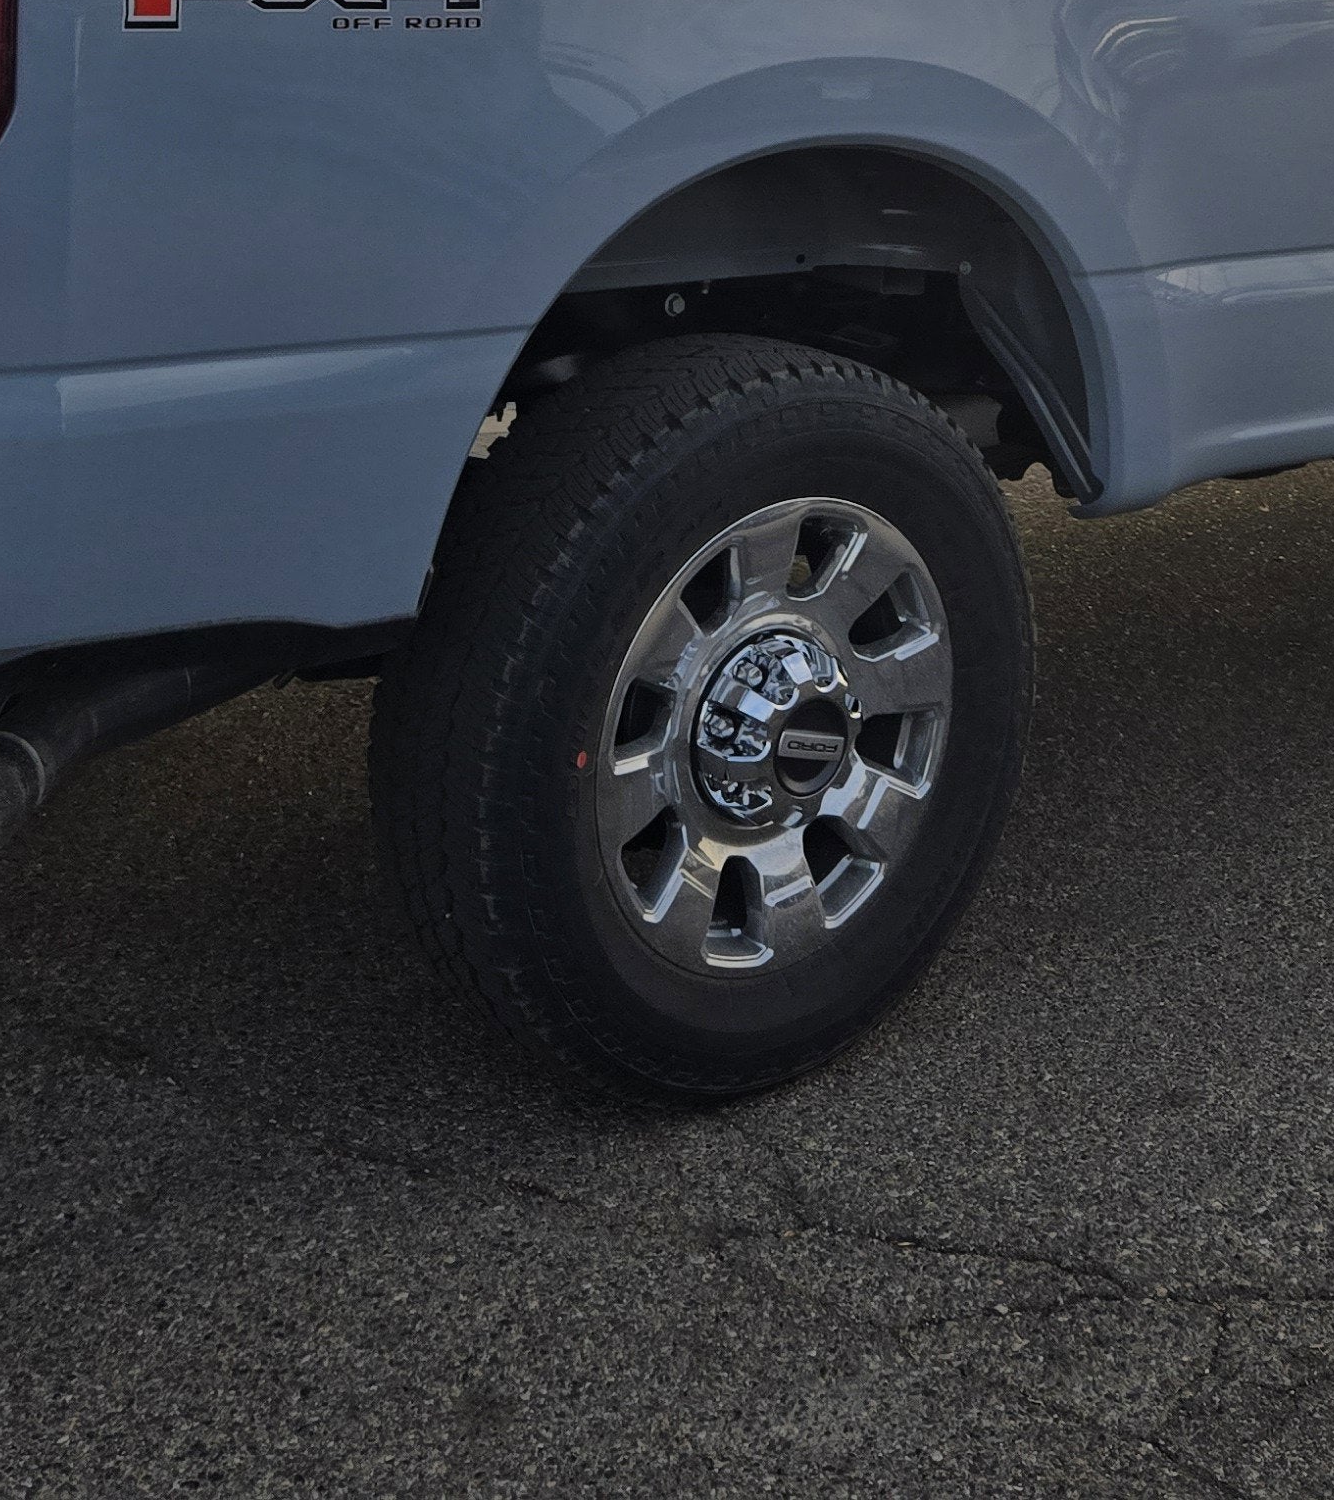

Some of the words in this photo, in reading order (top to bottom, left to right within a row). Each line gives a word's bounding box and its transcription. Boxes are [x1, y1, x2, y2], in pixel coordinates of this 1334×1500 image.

[331, 16, 392, 31] OFF
[404, 15, 483, 31] ROAD
[787, 740, 839, 753] FORD
